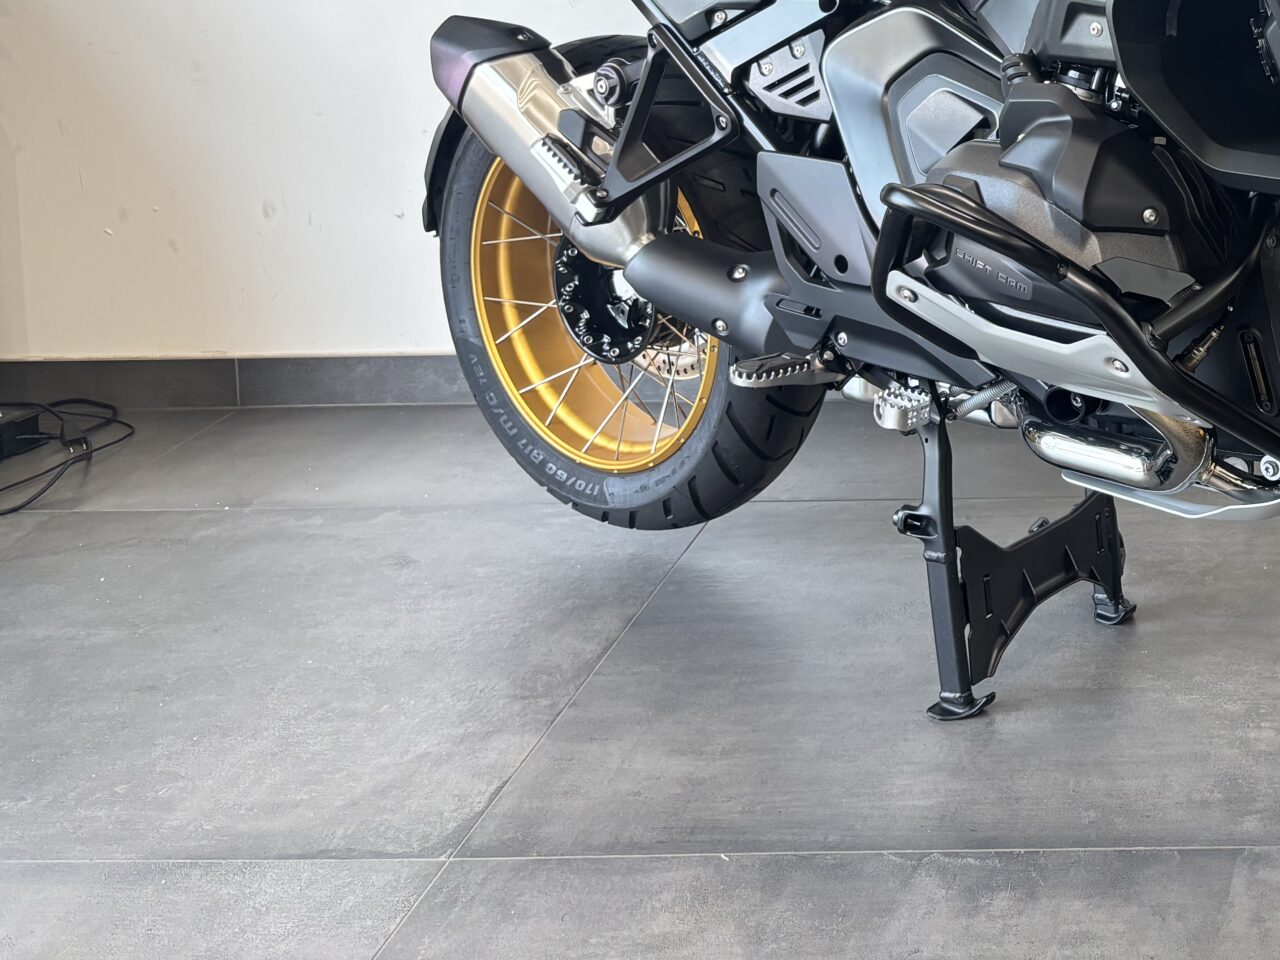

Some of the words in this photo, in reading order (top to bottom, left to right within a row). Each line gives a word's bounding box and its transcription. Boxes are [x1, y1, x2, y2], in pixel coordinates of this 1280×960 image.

[956, 248, 992, 275] SHIFT
[997, 271, 1028, 294] CAM
[486, 392, 518, 437] M/C
[517, 438, 545, 465] R17
[545, 461, 600, 496] 170/60
